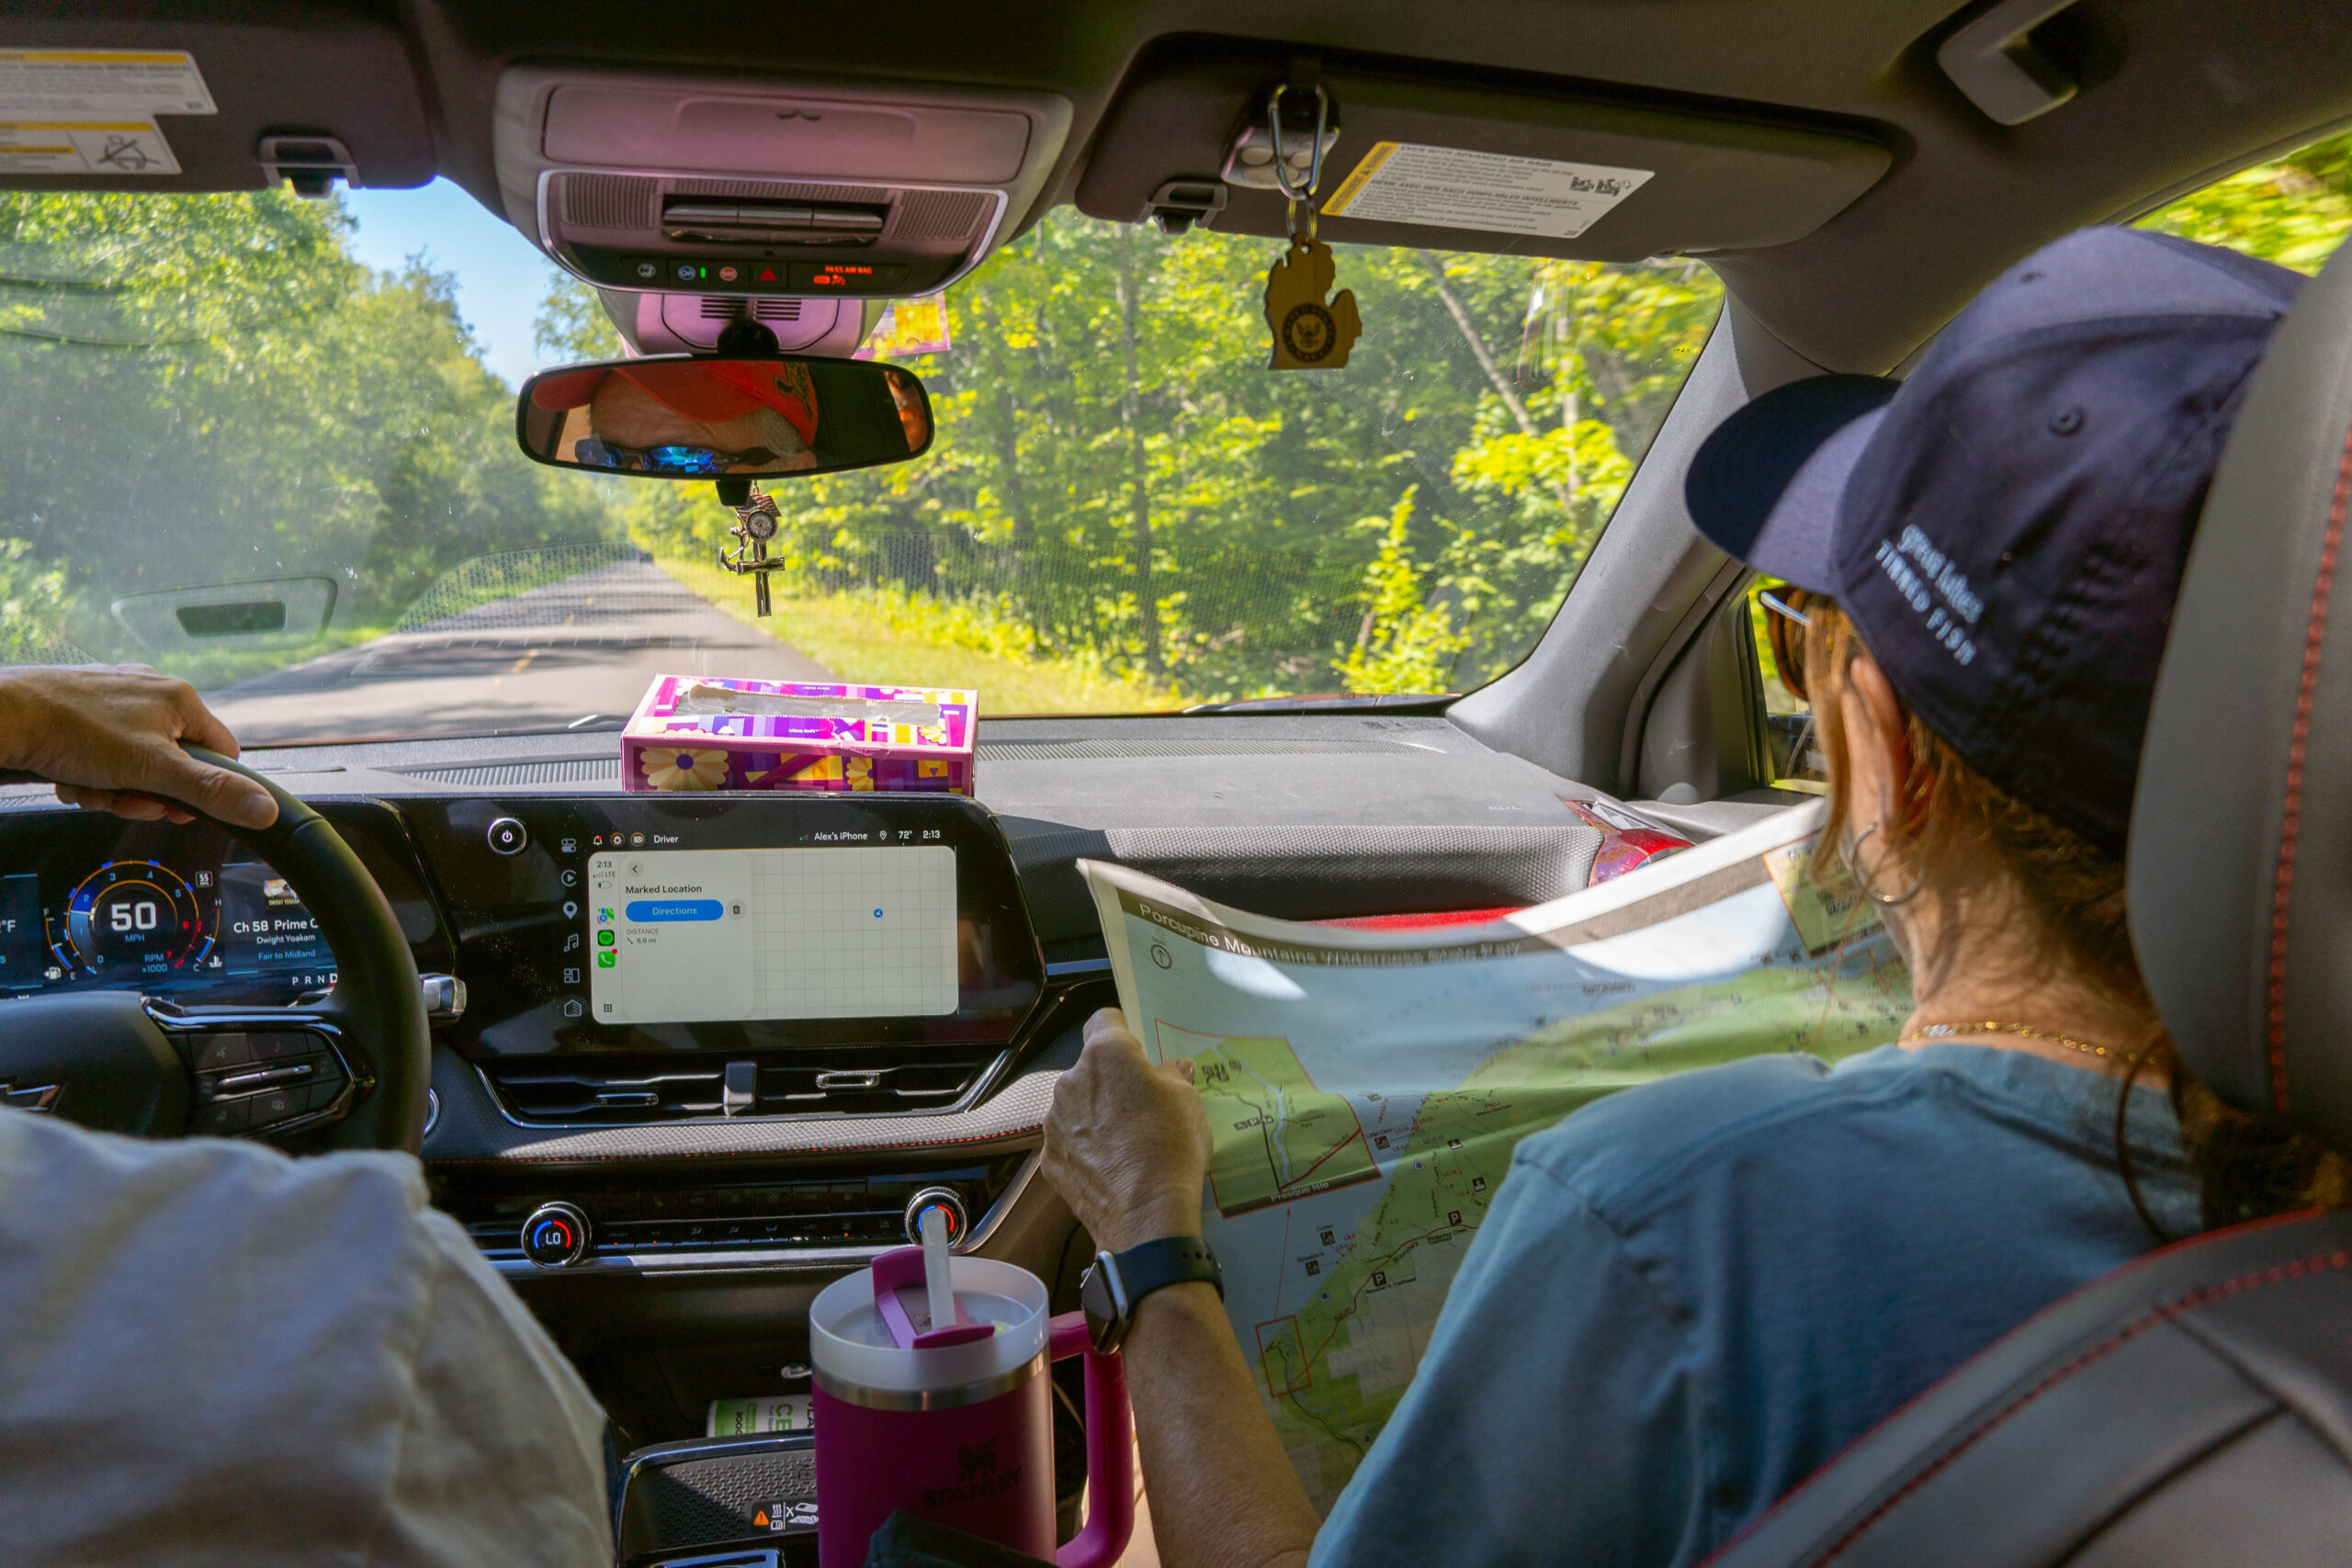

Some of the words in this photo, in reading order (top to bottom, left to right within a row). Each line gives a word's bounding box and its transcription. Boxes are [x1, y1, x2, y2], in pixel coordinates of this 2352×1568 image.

[825, 265, 843, 274] PASS
[844, 265, 857, 274] AIR
[857, 266, 873, 275] BAG
[1875, 538, 1930, 613] TINNED
[1927, 607, 1977, 666] FISH
[653, 835, 679, 844] Driver
[814, 831, 839, 840] Alex's
[840, 831, 868, 840] iPhone
[899, 830, 912, 840] 72°
[922, 830, 941, 839] 2:13
[596, 861, 612, 869] 2:13
[109, 873, 116, 882] 3
[147, 870, 153, 880] 4
[199, 874, 209, 883] 55
[175, 888, 181, 898] 5
[626, 885, 661, 895] Marked
[662, 884, 702, 894] Location
[84, 894, 90, 902] 2
[215, 898, 222, 908] H
[43, 908, 49, 917] F
[110, 901, 157, 932] 50
[652, 907, 697, 917] Directions
[233, 921, 250, 934] Ch
[253, 920, 269, 932] 58
[275, 919, 307, 931] Prime
[626, 928, 659, 936] DISTANCE
[1138, 902, 1220, 948] Porcupine
[1224, 936, 1317, 964] Mountains
[125, 933, 145, 943] MPH
[256, 935, 284, 945] Dwight
[286, 933, 316, 942] Yoakam
[96, 954, 104, 964] 0
[144, 953, 164, 963] RPM
[166, 950, 173, 959] 7
[258, 952, 273, 961] Fair
[285, 949, 316, 958] Midland
[141, 964, 167, 974] x1000
[194, 964, 200, 973] C
[292, 976, 299, 986] P
[305, 976, 311, 985] R
[318, 975, 325, 984] N
[330, 973, 338, 984] D
[1270, 1184, 1311, 1202] Presque
[1311, 1180, 1330, 1193] Isle
[546, 1232, 560, 1245] LO
[922, 1464, 1023, 1507] STANLEY
